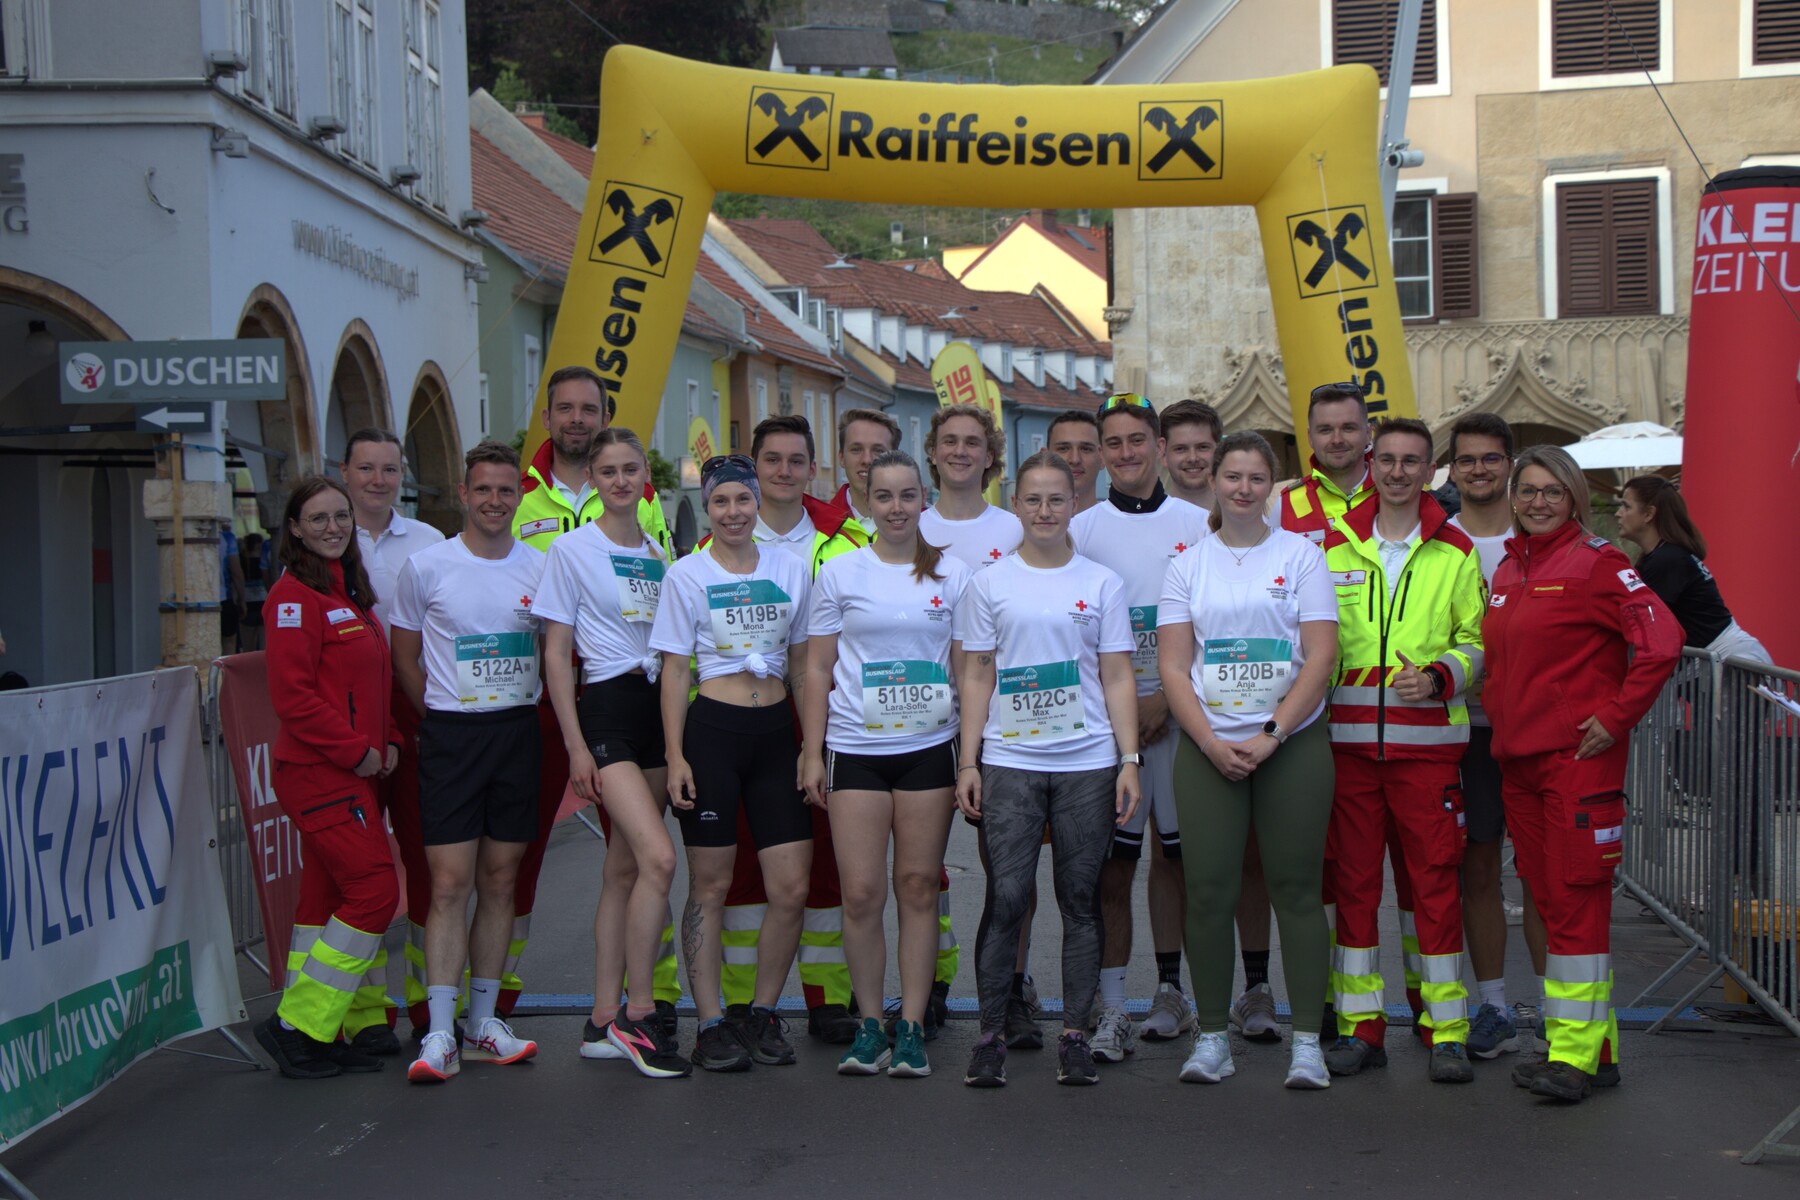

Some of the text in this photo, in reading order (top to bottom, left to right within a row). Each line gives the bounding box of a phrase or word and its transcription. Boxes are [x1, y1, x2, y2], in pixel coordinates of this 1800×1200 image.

[837, 110, 1131, 167] Raiffeisen
[113, 355, 279, 387] DUSCHEN
[629, 578, 661, 598] 5119
[711, 589, 750, 599] BUSINESSLAUF
[726, 604, 778, 625] 5119B
[743, 623, 765, 631] Mona
[459, 641, 499, 650] BUSINESSLAUF
[1135, 631, 1158, 649] 20
[1136, 648, 1156, 656] Felix
[1207, 646, 1248, 654] BUSINESSLAUF
[472, 658, 524, 677] 5122A
[865, 668, 906, 677] BUSINESSLAUF
[1218, 662, 1274, 681] 5120B
[485, 675, 515, 684] Michael
[1236, 681, 1256, 690] Anja
[878, 685, 933, 704] 5119C
[1012, 688, 1067, 711] 5122C
[885, 702, 928, 711] Lara-Sofie
[1032, 709, 1050, 717] Max
[253, 814, 303, 884] ZEIT
